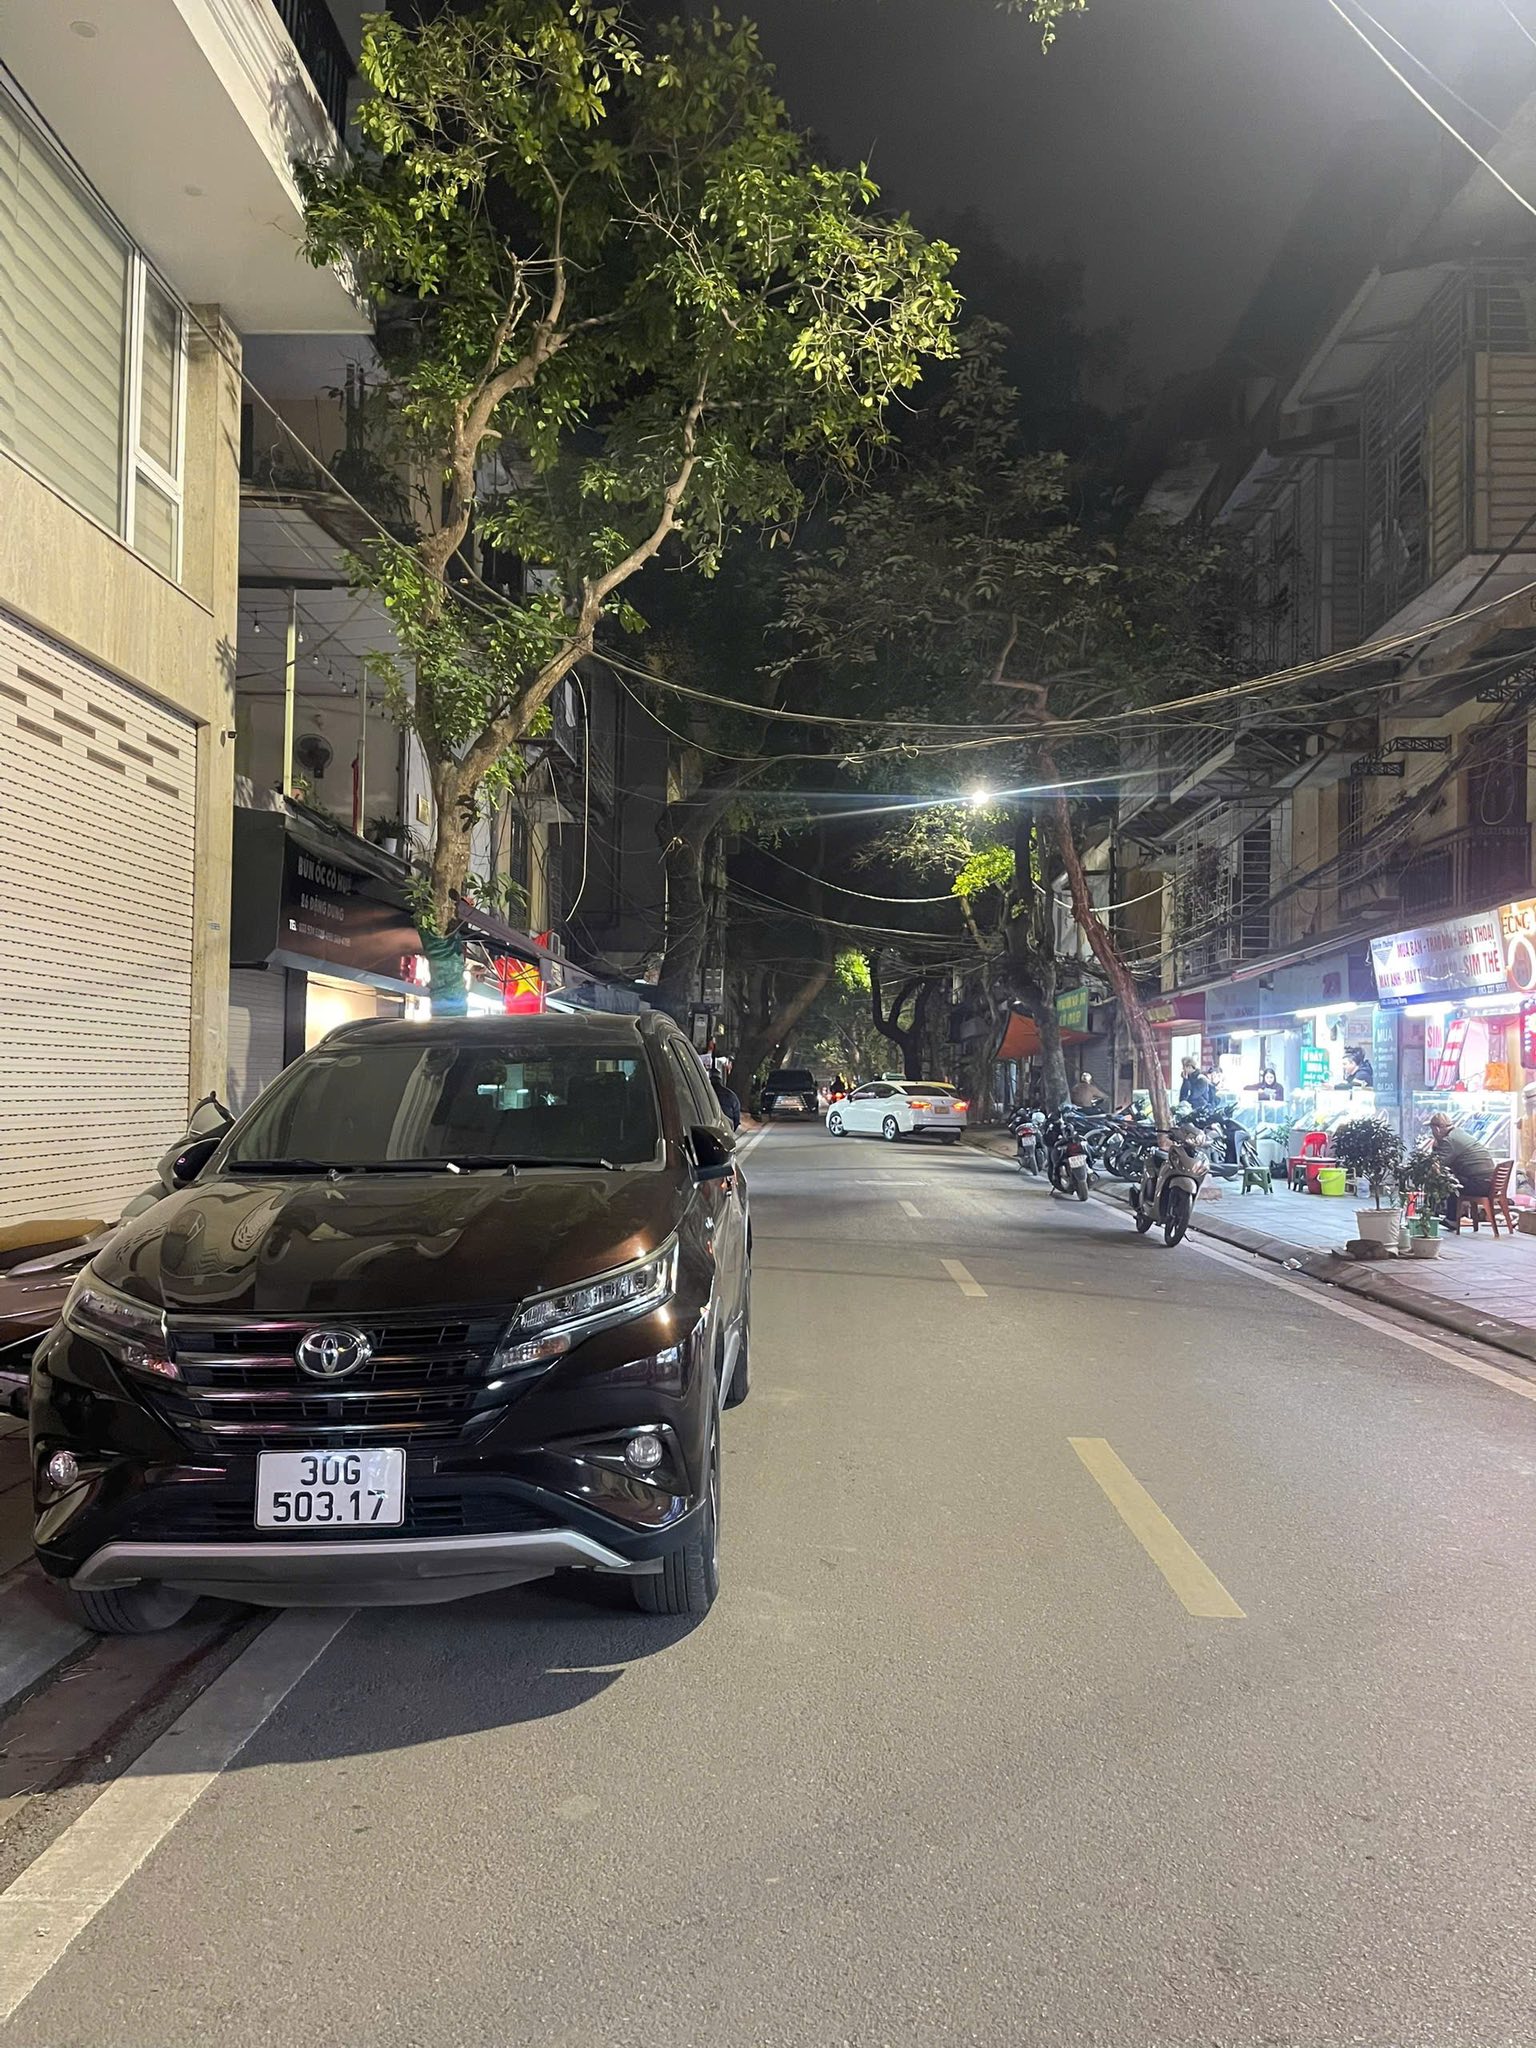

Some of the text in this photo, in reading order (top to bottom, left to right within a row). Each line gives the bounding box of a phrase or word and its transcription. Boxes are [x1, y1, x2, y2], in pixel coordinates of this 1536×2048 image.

[297, 853, 314, 880] BÚN
[314, 860, 326, 885] ỐC
[1397, 941, 1410, 958] MUA
[1463, 952, 1482, 978] SIM
[1376, 1028, 1394, 1042] MUA
[301, 1455, 361, 1486] 30G
[273, 1490, 386, 1522] 503.17
